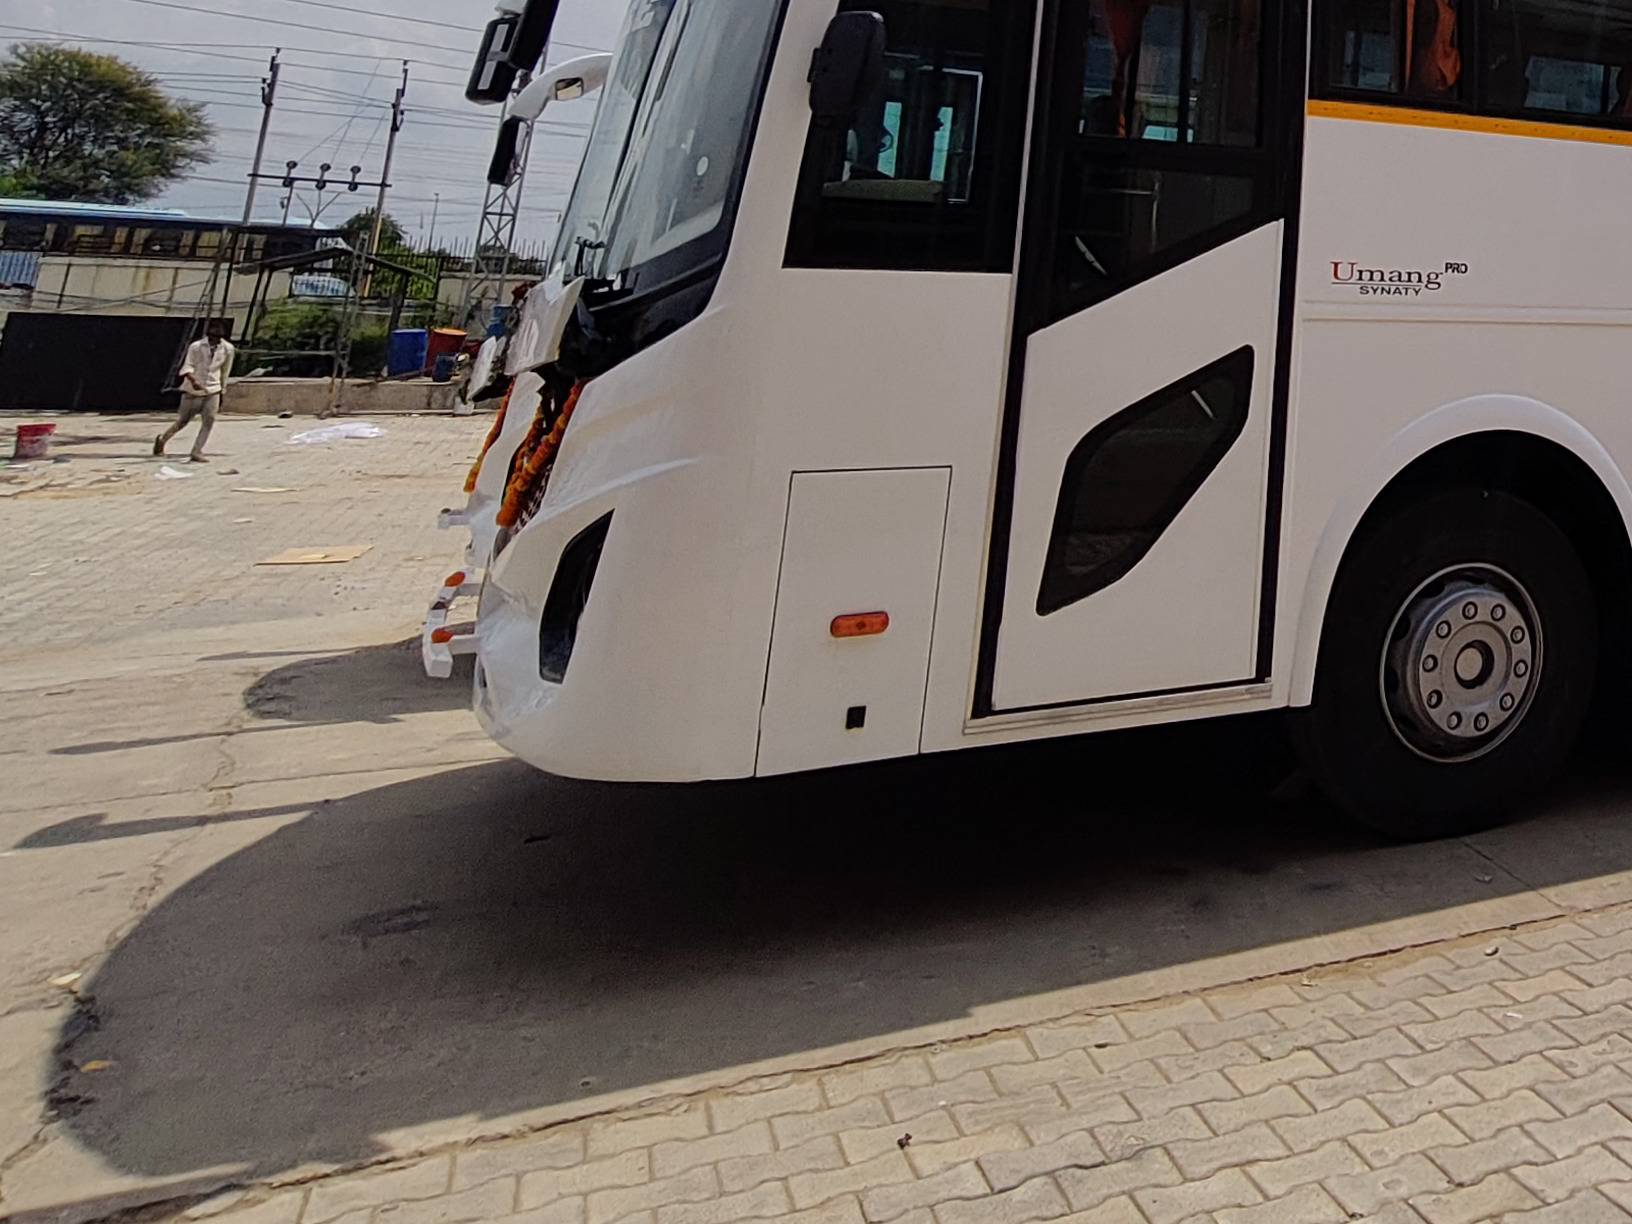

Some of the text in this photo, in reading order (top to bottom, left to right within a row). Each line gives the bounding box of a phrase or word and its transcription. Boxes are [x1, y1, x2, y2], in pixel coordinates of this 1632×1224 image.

[1330, 261, 1468, 290] Umang PRO
[1359, 286, 1422, 296] SYNATY
